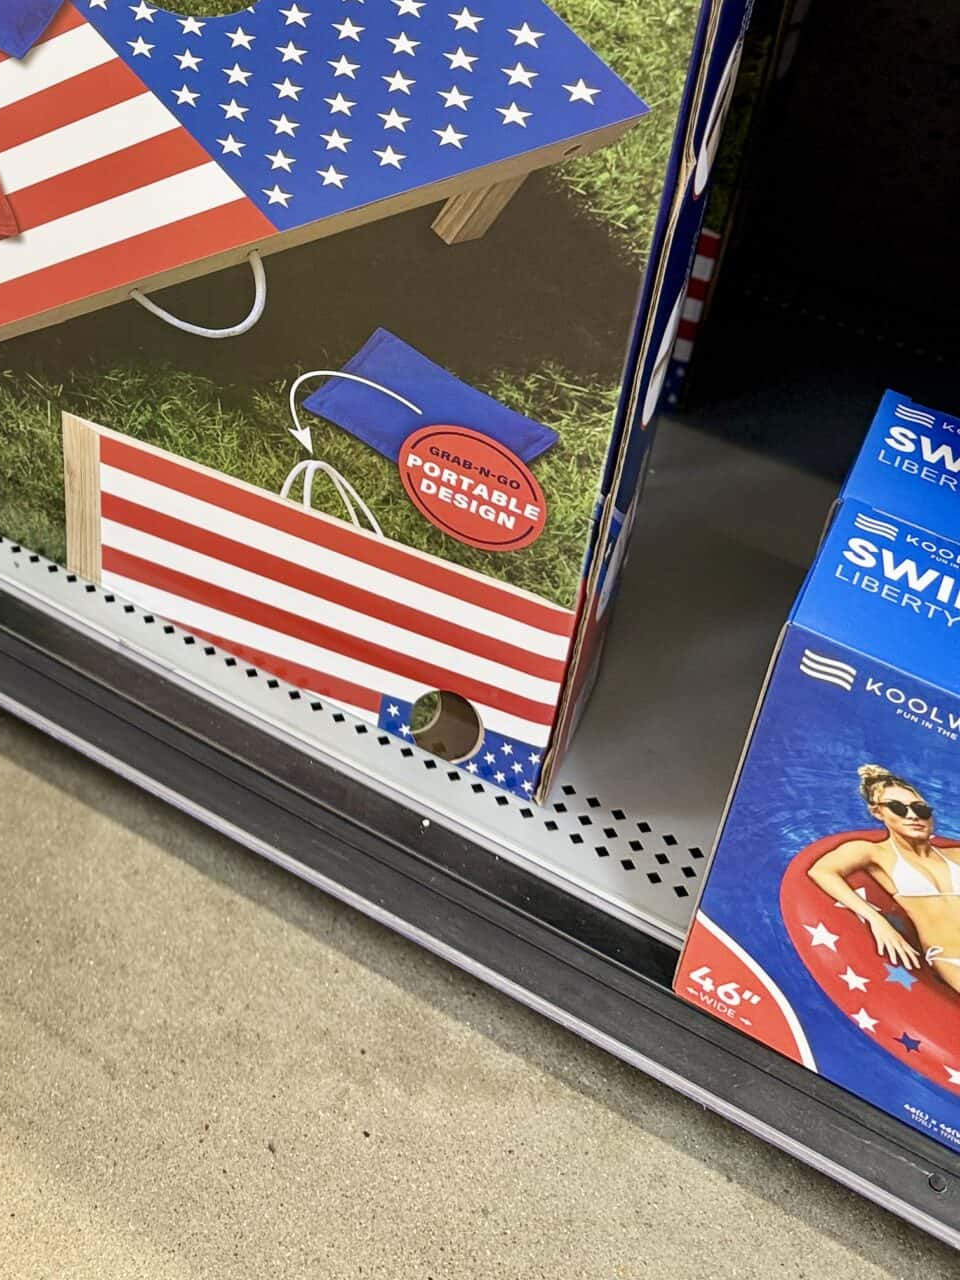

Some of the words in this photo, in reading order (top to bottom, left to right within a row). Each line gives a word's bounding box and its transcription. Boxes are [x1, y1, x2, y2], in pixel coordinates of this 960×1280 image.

[406, 453, 541, 521] PORTABLE
[429, 446, 521, 490] GRAB-N-GO
[877, 449, 958, 492] LIBER
[420, 478, 516, 530] DESIGN
[842, 537, 960, 609] SWI
[835, 564, 960, 627] LIBERTY
[896, 709, 919, 723] FUN
[921, 720, 933, 729] IN
[937, 727, 958, 740] THE
[688, 966, 761, 1007] 46"
[700, 992, 736, 1019] WIDE
